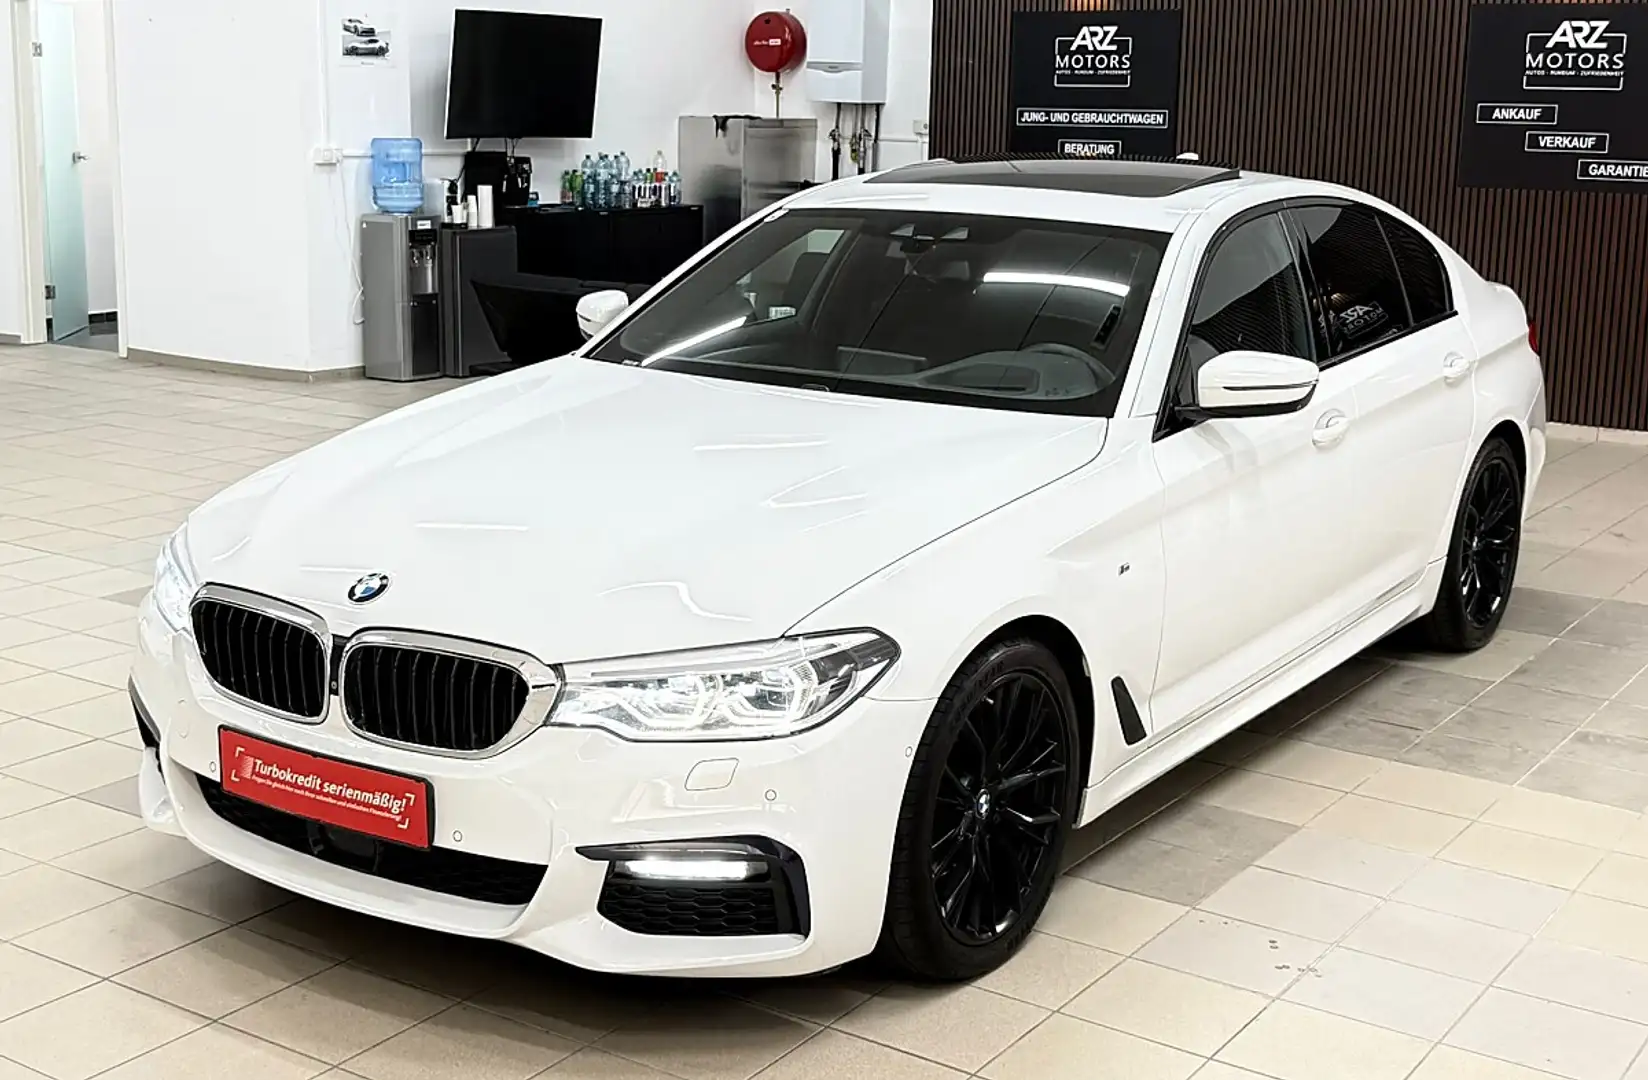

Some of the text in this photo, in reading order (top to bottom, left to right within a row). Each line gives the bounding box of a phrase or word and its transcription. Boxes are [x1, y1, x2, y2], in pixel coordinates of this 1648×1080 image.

[1070, 26, 1118, 51] ARZ
[1545, 20, 1610, 49] ARZ
[1055, 54, 1130, 69] MOTORS
[1525, 52, 1624, 69] MOTORS
[1020, 112, 1164, 125] JUNG- UND GEBRAUCHTWAGEN
[1492, 108, 1542, 120] ANKAUF
[1064, 143, 1115, 156] BERATUNG
[1538, 136, 1597, 149] VERKAUF
[1588, 164, 1648, 177] GARANTIE
[254, 759, 321, 790] Turbokredit
[323, 783, 407, 814] serienmäßig!
